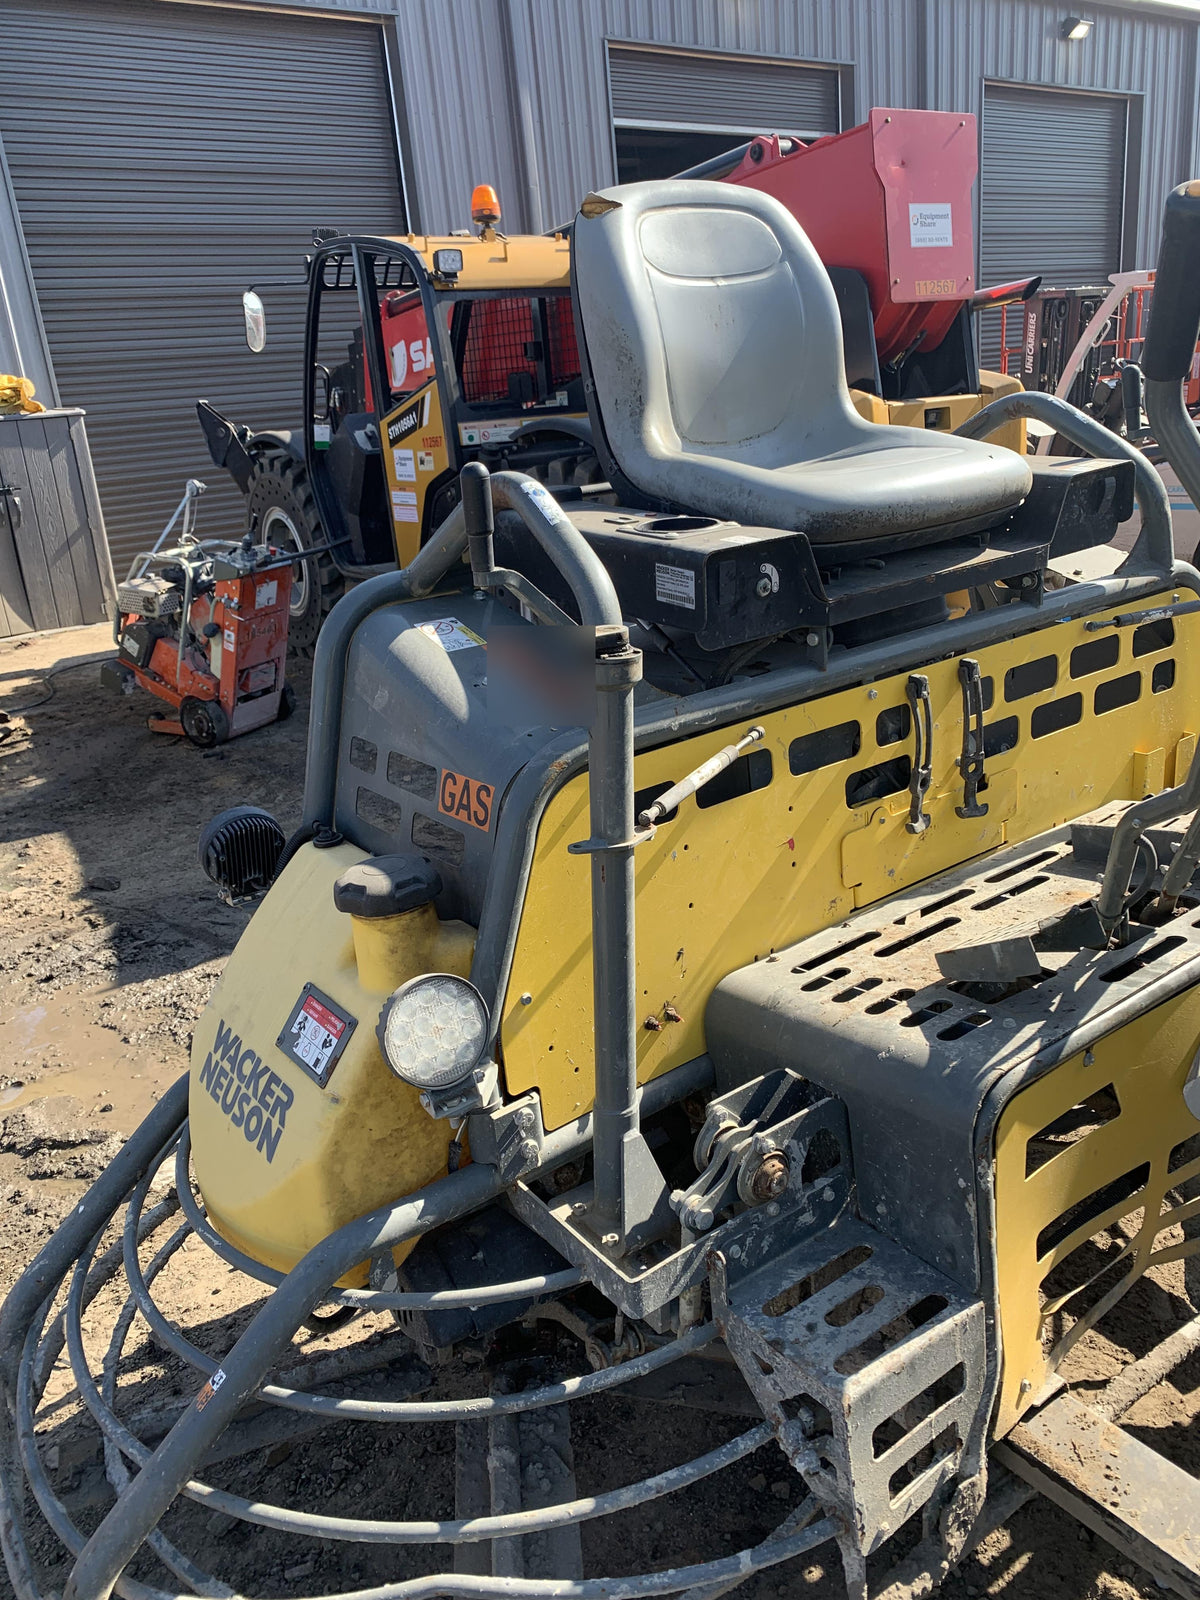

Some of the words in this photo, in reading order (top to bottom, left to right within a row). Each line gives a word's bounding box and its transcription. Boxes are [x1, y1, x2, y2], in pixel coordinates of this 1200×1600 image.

[920, 212, 949, 221] Equipment
[916, 280, 955, 295] 112567
[441, 772, 491, 827] GAS
[213, 1019, 294, 1129] WACKER
[199, 1051, 283, 1164] NEUSON
